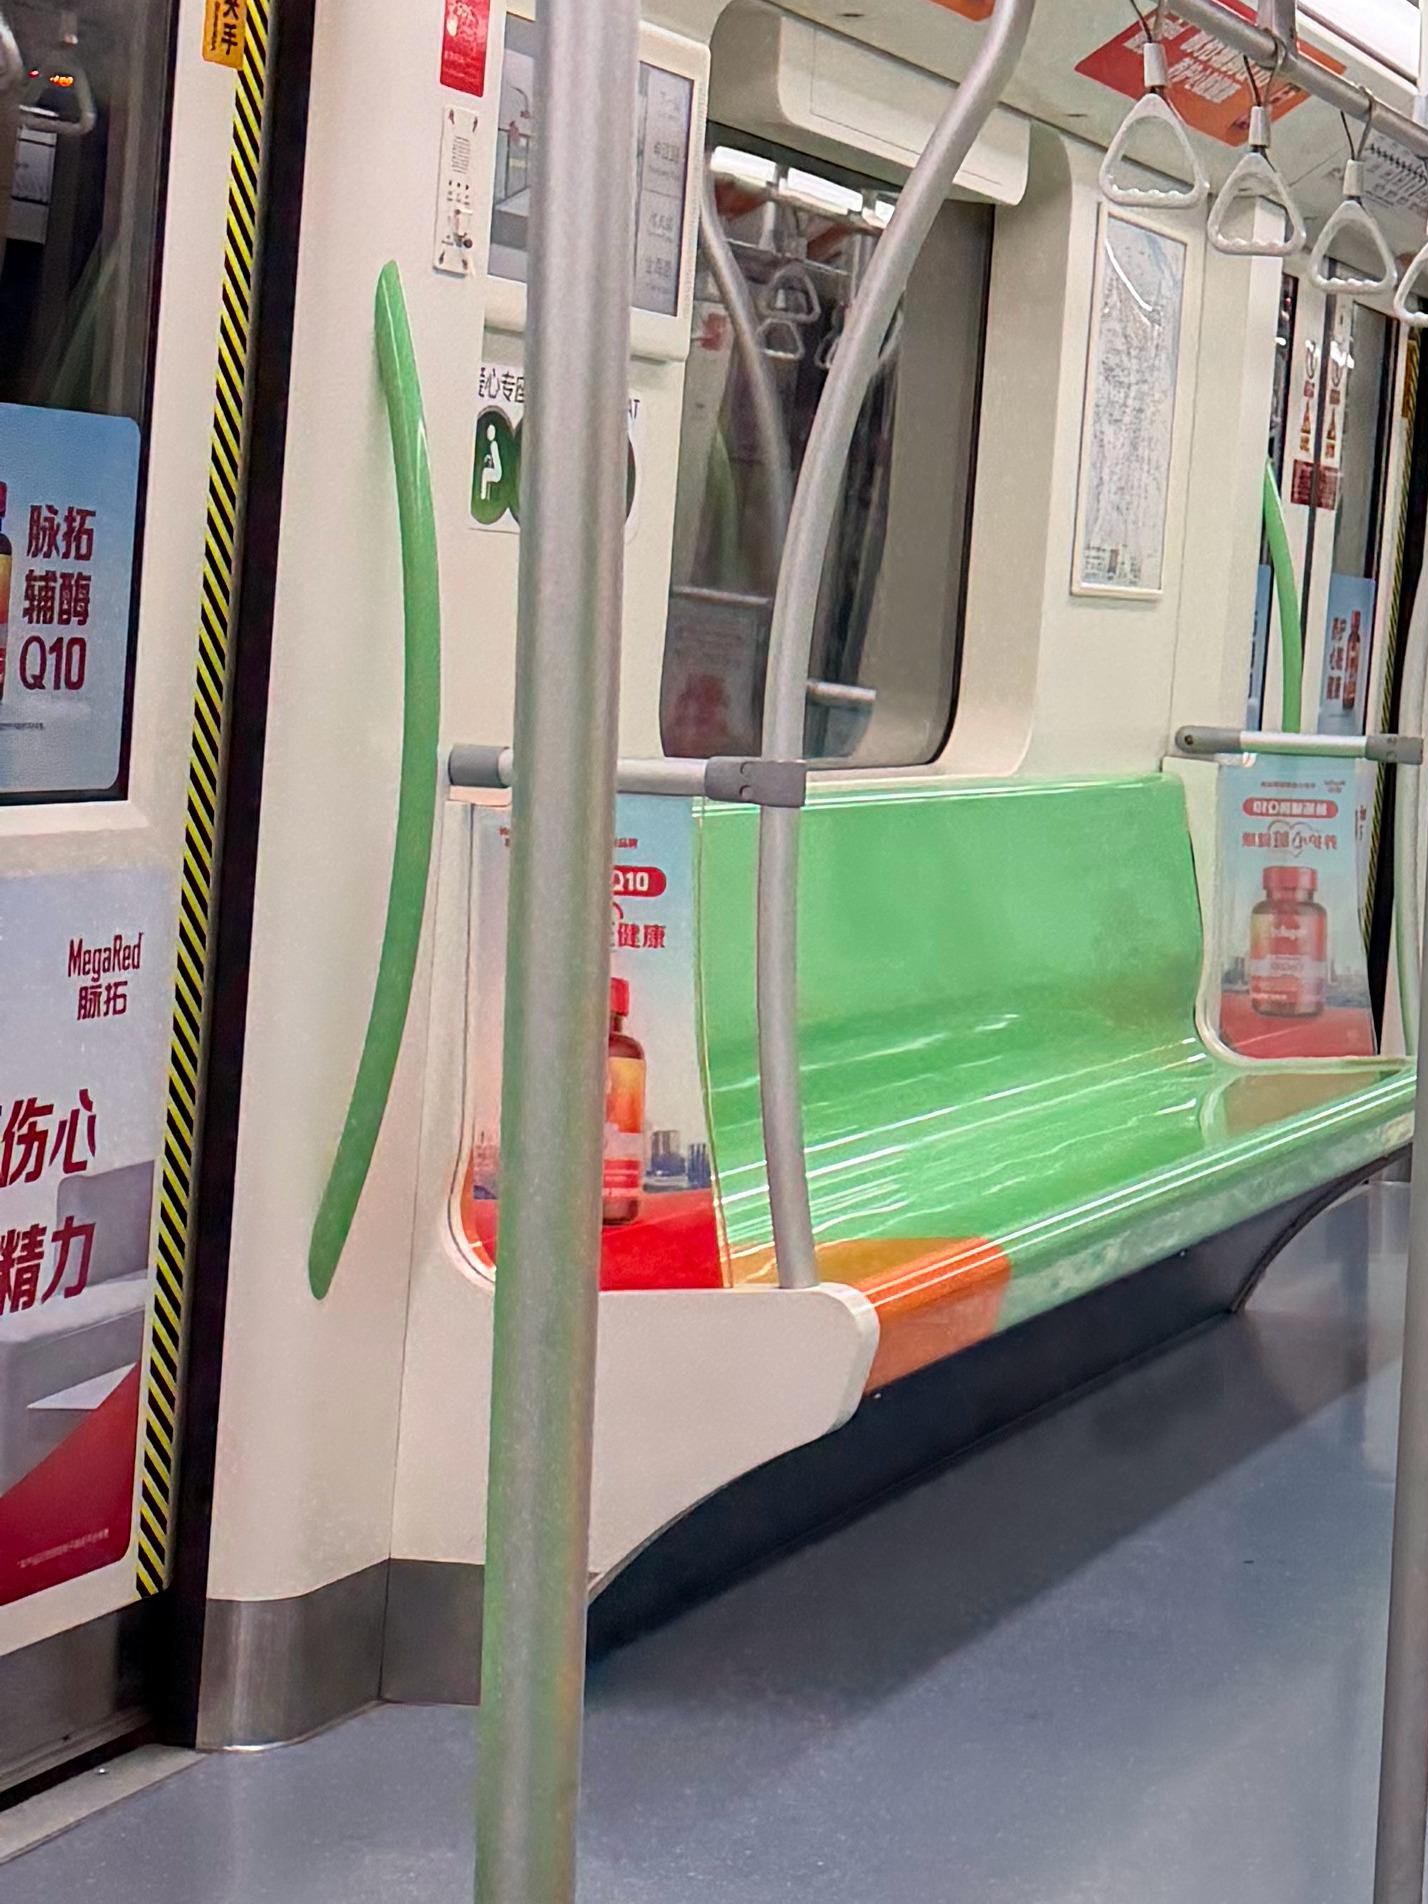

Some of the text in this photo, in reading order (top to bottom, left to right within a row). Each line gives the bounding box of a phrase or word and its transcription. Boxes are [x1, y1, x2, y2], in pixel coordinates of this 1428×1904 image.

[26, 504, 97, 561] 脉拓
[22, 569, 92, 626] 辅酶
[19, 635, 88, 691] Q10
[68, 932, 144, 978] MegaRed
[77, 981, 129, 1021] 脉拓
